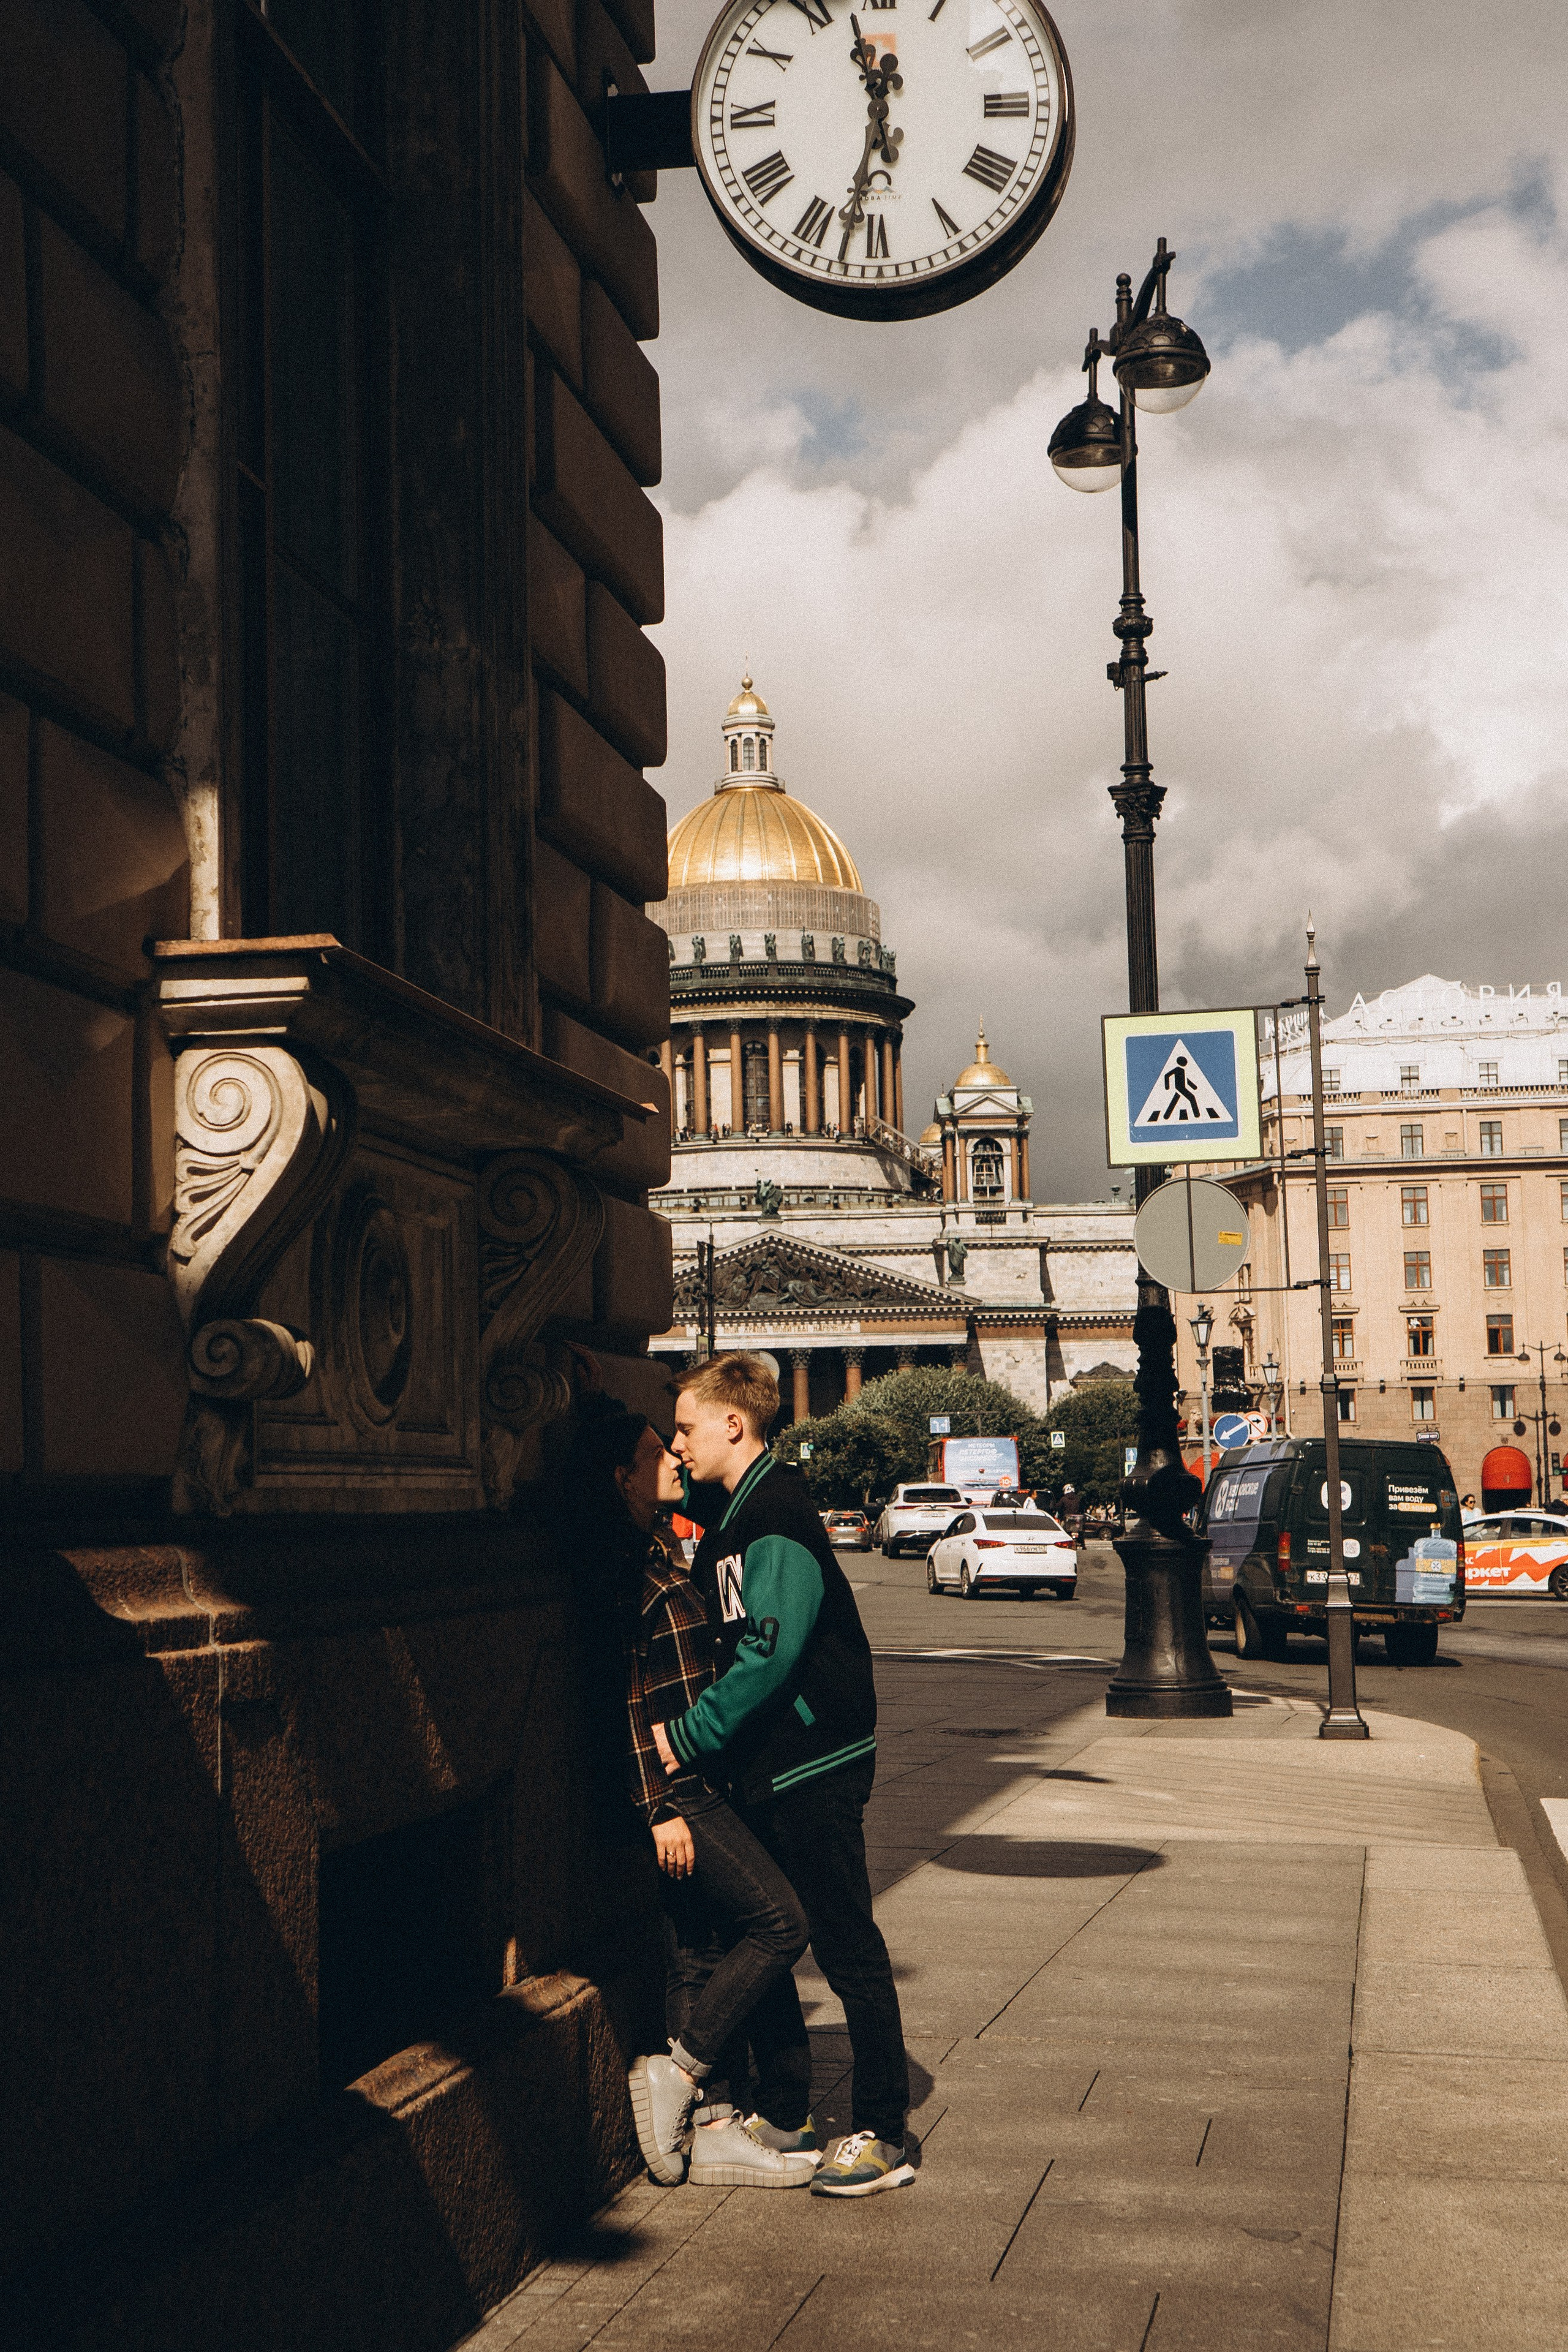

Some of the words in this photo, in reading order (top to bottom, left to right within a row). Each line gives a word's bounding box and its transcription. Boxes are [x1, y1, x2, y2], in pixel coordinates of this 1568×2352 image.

[746, 38, 794, 72] X
[730, 99, 776, 130] IX
[984, 91, 1030, 118] III
[741, 149, 795, 207] VIII
[792, 195, 835, 248] VII
[931, 197, 962, 239] V
[864, 214, 891, 258] VI
[1348, 981, 1562, 1014] АСТОРИЯ
[1388, 1484, 1429, 1494] Привезём
[1465, 1567, 1512, 1580] ркет
